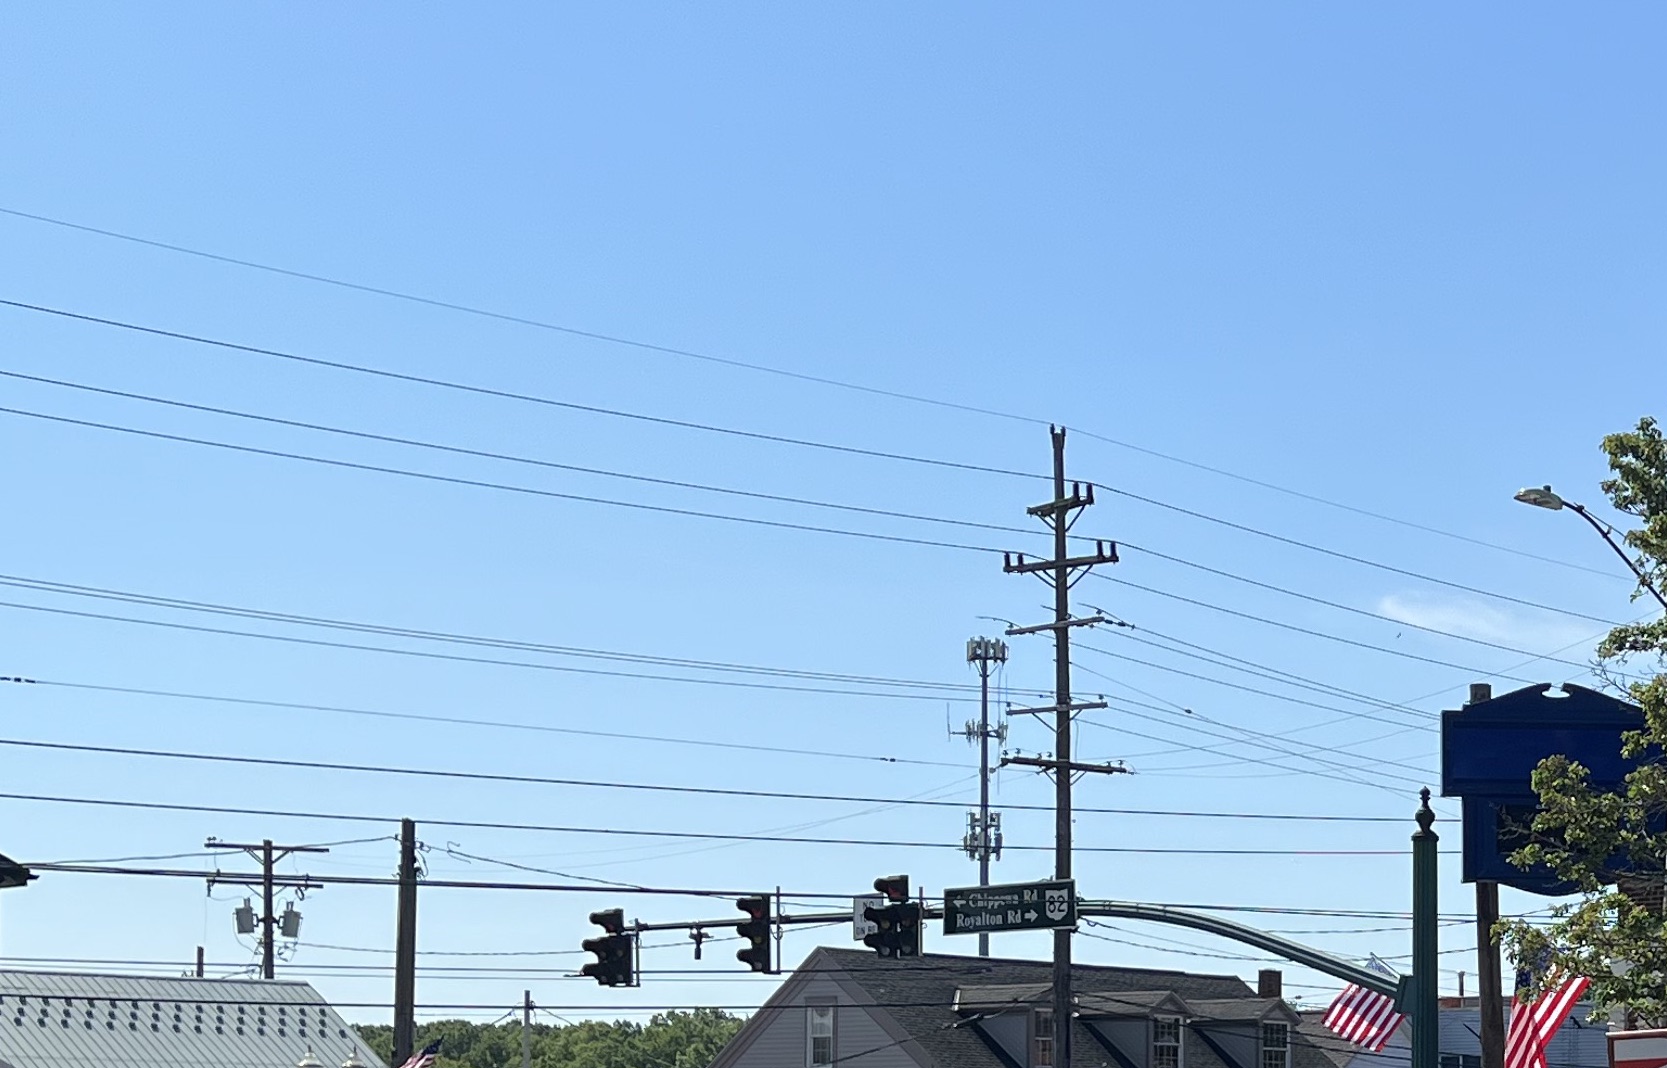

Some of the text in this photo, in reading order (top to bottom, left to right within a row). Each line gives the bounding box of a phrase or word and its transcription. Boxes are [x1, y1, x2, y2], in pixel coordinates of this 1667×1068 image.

[1023, 889, 1037, 903] Rd
[1048, 895, 1065, 913] 82
[956, 909, 1021, 928] Royalton Rd
